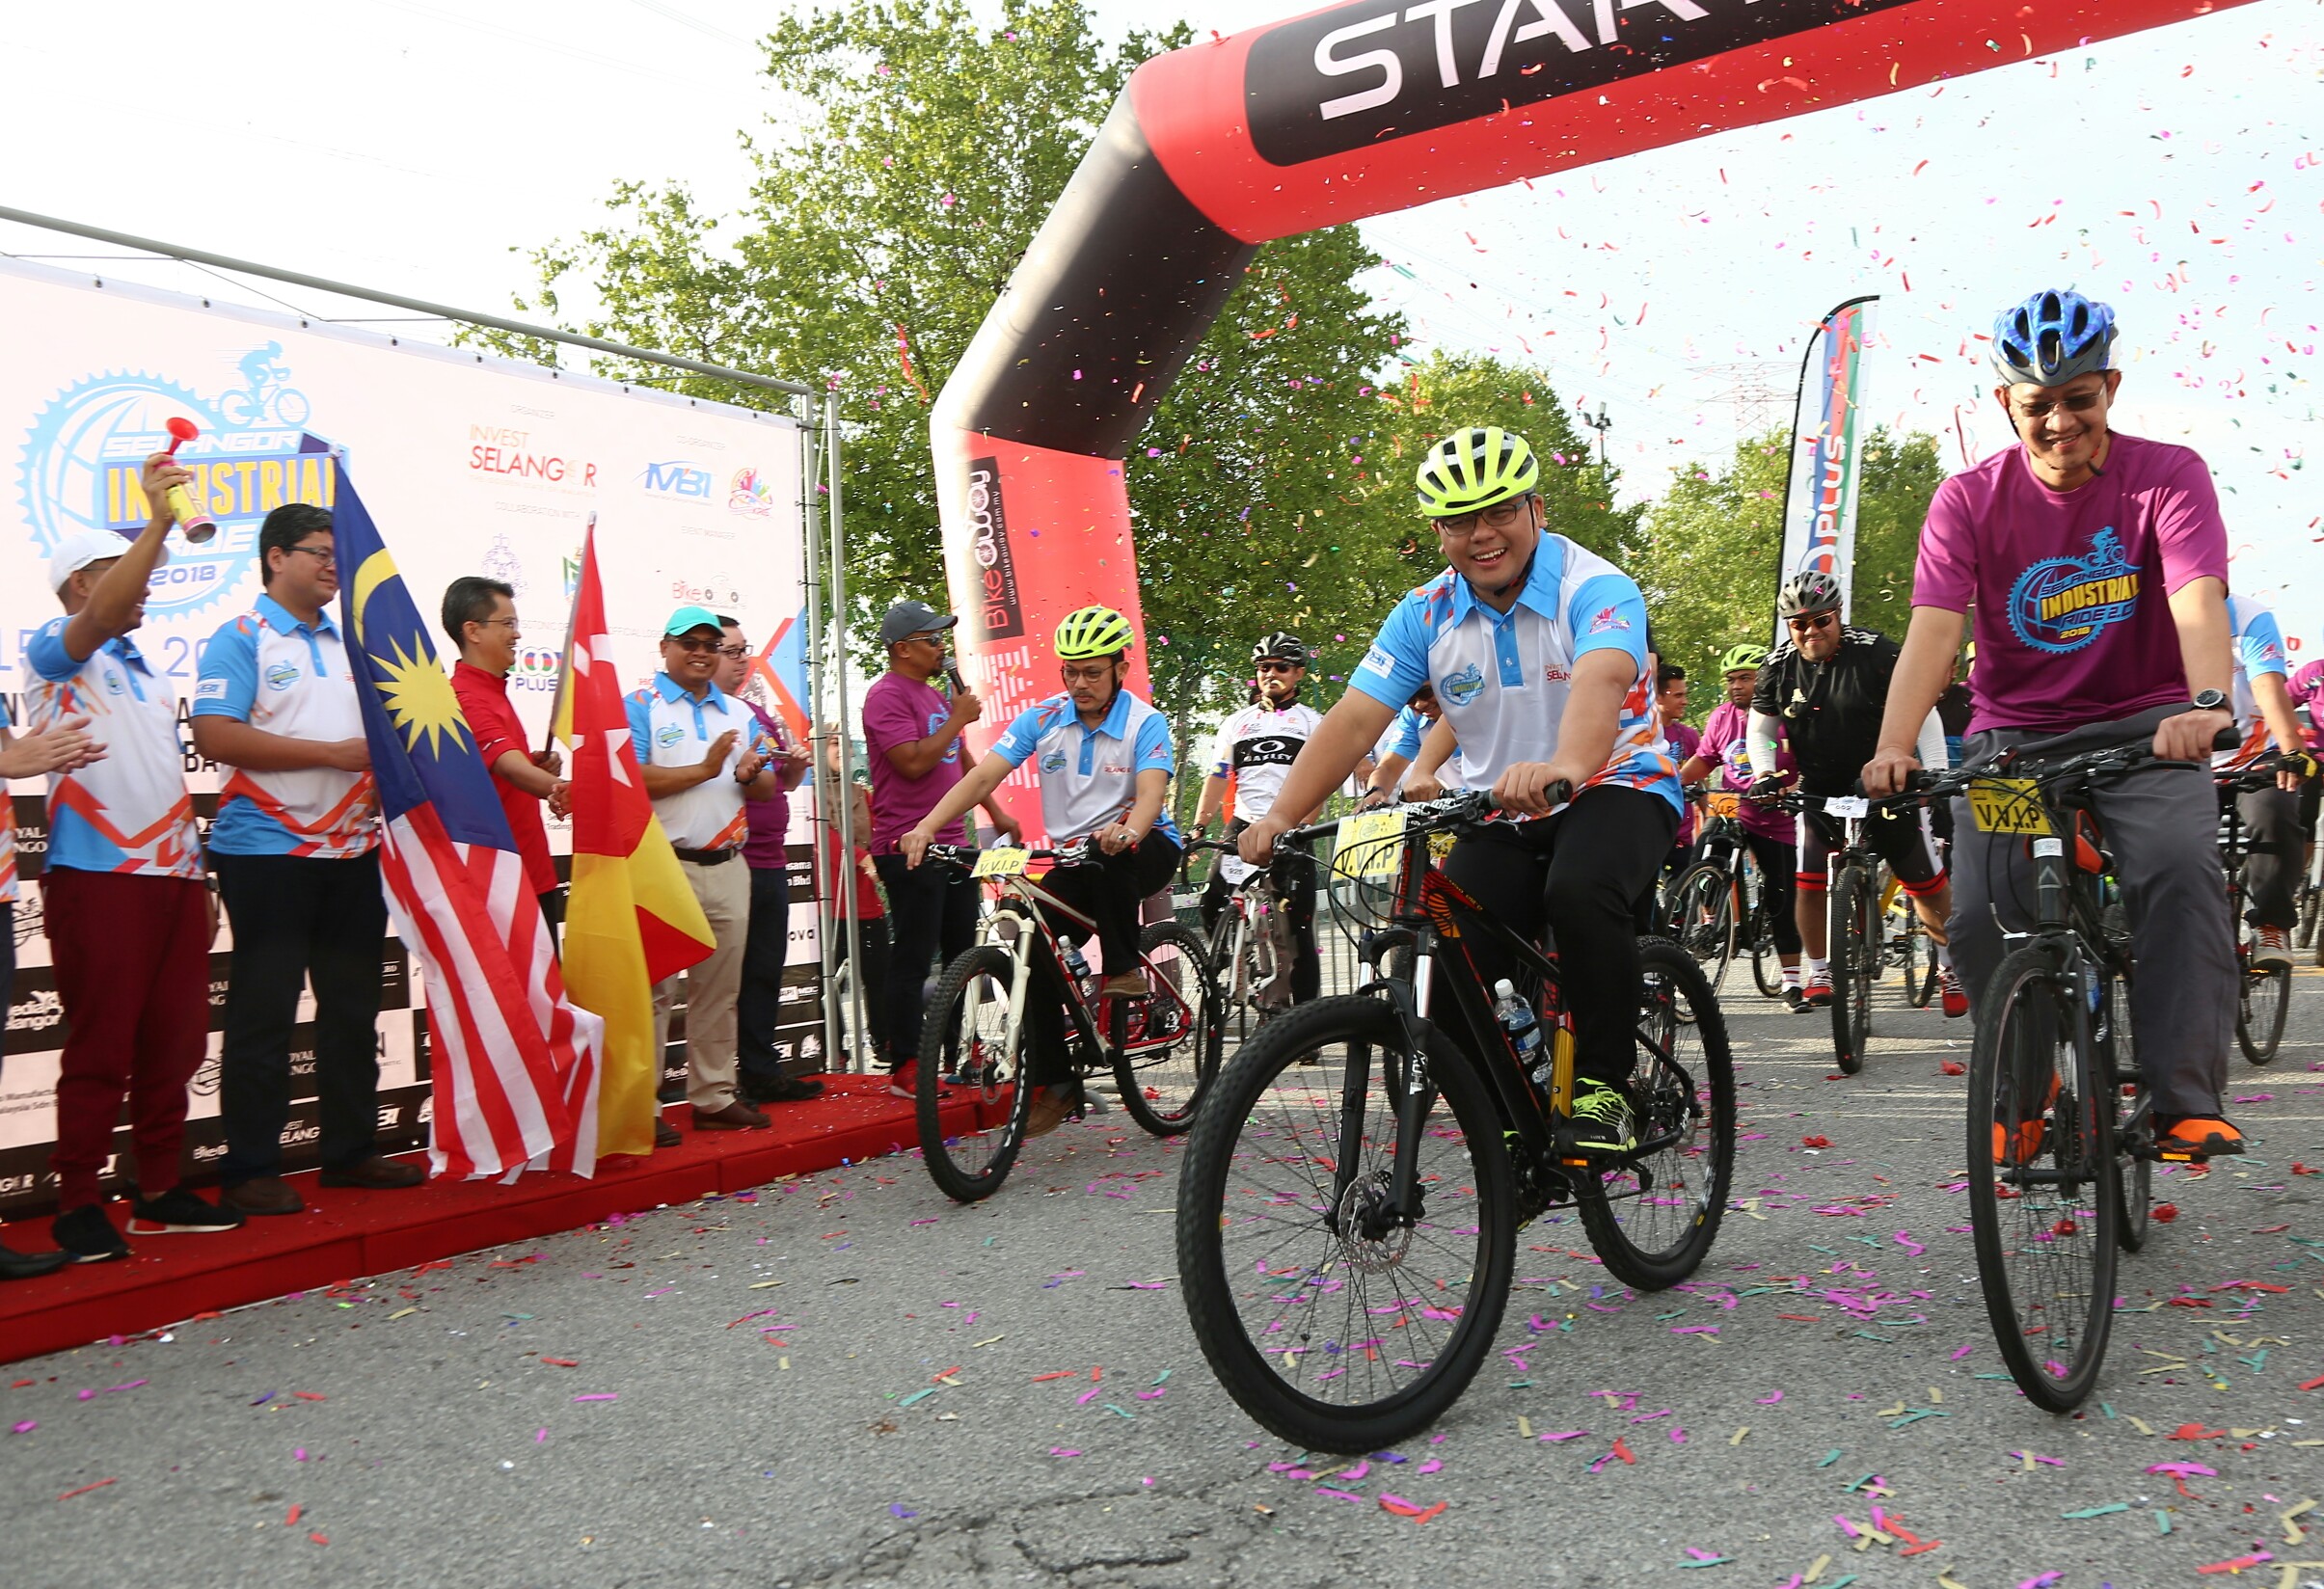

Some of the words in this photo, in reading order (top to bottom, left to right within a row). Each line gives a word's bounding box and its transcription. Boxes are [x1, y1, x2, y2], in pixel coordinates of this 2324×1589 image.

[644, 462, 713, 498] MBI
[1815, 435, 1847, 538] PLUS
[149, 565, 216, 586] 2018
[2040, 565, 2123, 595] SELANGOR
[2041, 574, 2141, 621] INDUSTRIAL
[2059, 607, 2106, 628] RIDE
[2060, 627, 2092, 639] 2018
[516, 678, 556, 691] PLUS
